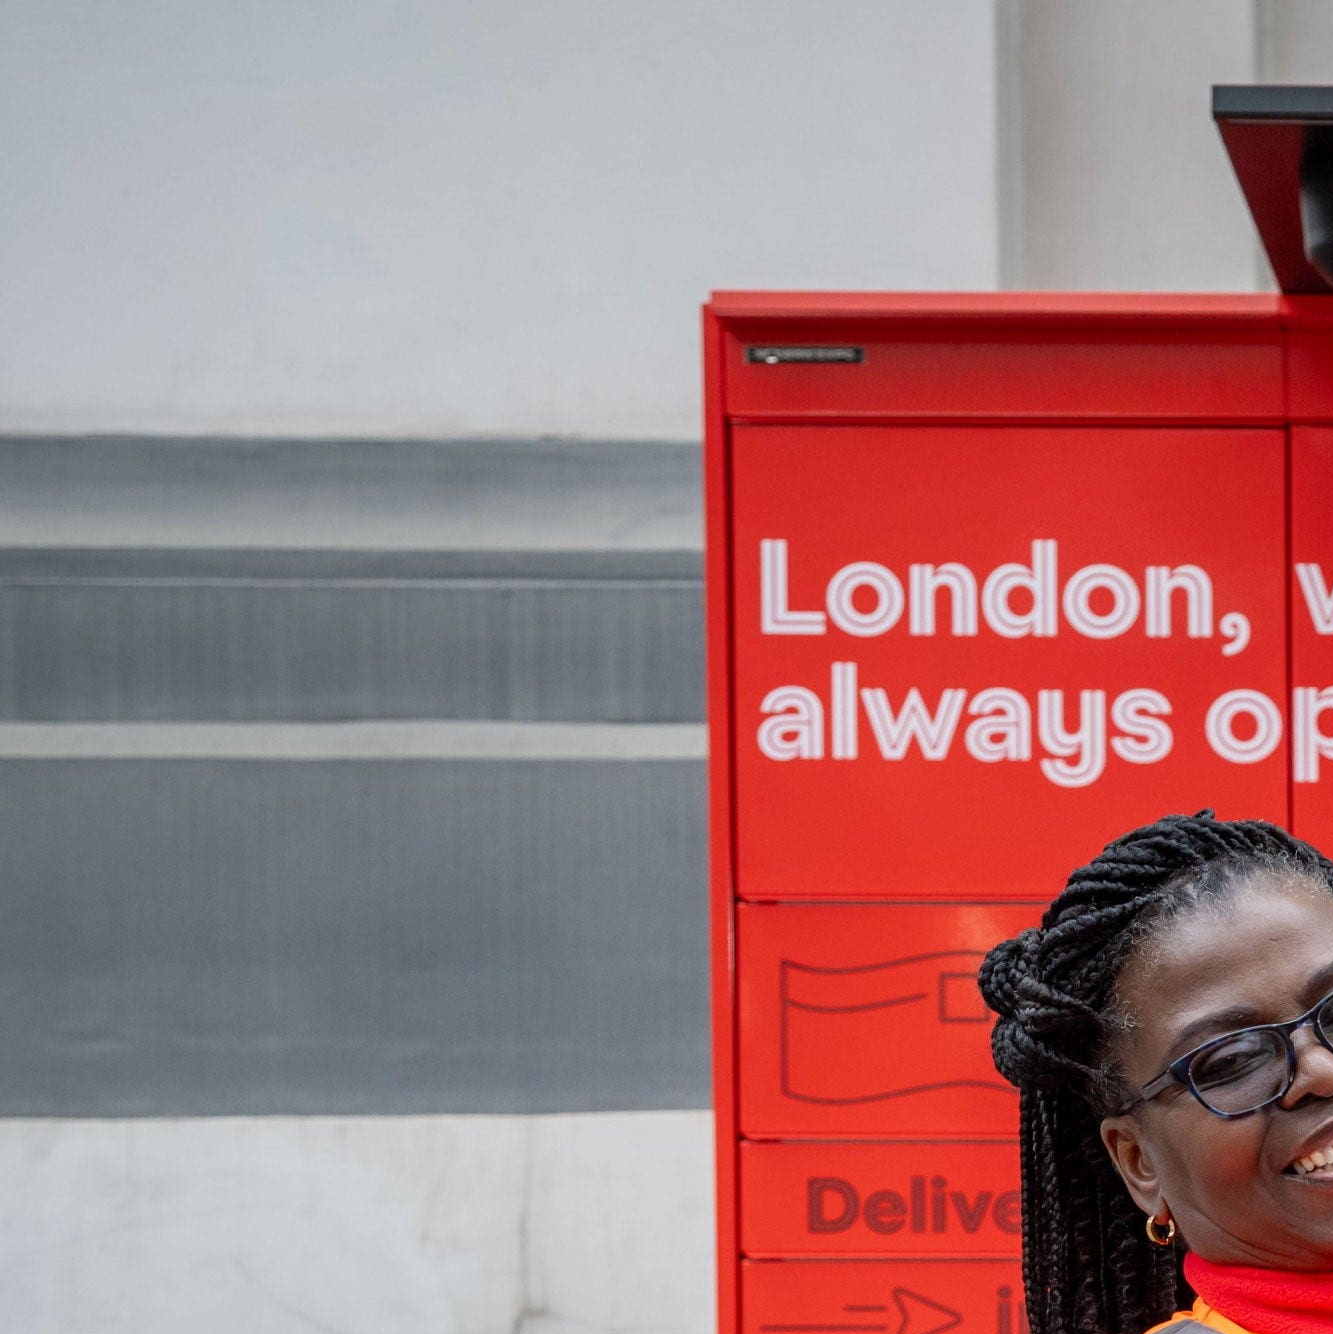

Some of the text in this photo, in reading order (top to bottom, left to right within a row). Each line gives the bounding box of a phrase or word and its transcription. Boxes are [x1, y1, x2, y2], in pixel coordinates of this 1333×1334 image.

[760, 538, 1251, 657] London,
[756, 661, 1175, 789] always
[806, 1174, 1021, 1235] Delive
